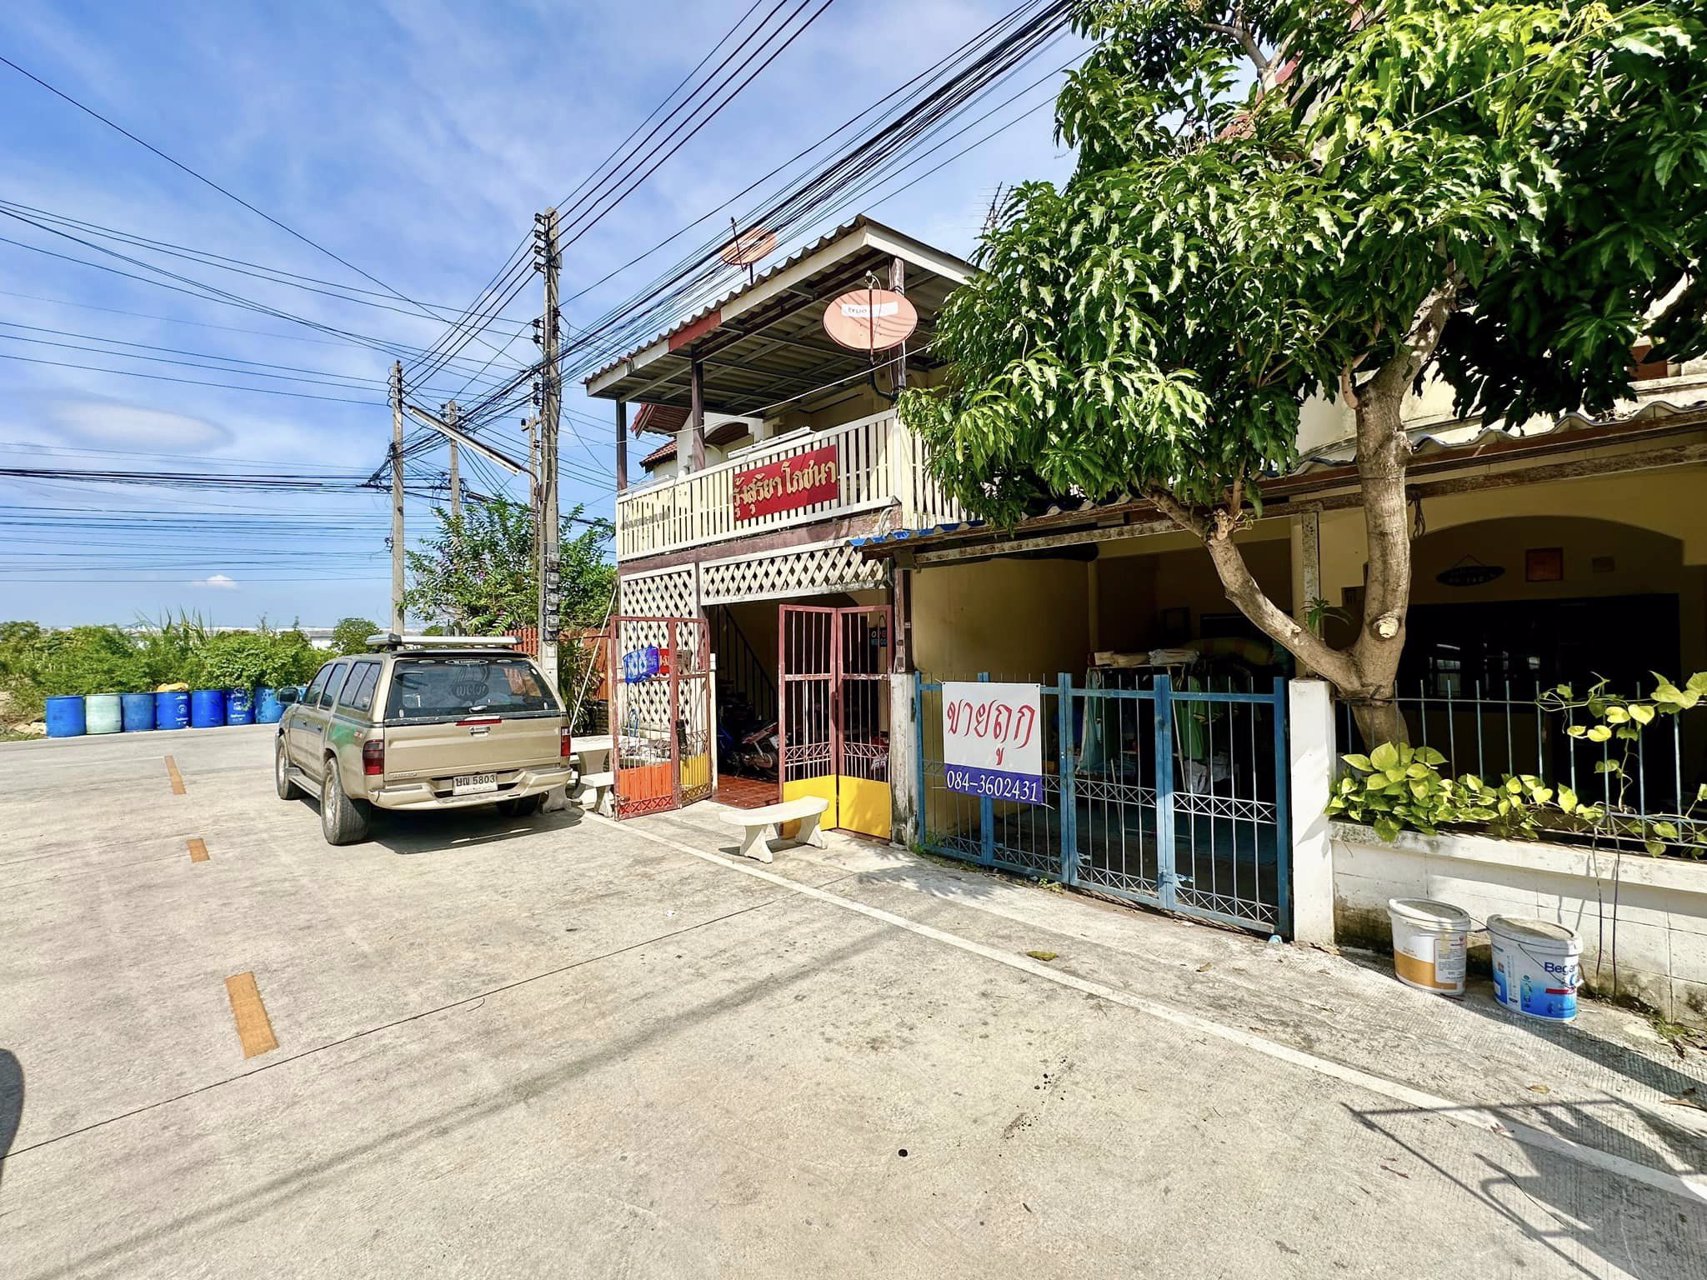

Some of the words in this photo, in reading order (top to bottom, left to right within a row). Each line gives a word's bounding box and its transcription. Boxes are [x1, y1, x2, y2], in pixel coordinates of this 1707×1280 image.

[947, 699, 1035, 766] ขายถูก
[472, 774, 496, 785] 5803
[947, 770, 1037, 802] 084-3602431
